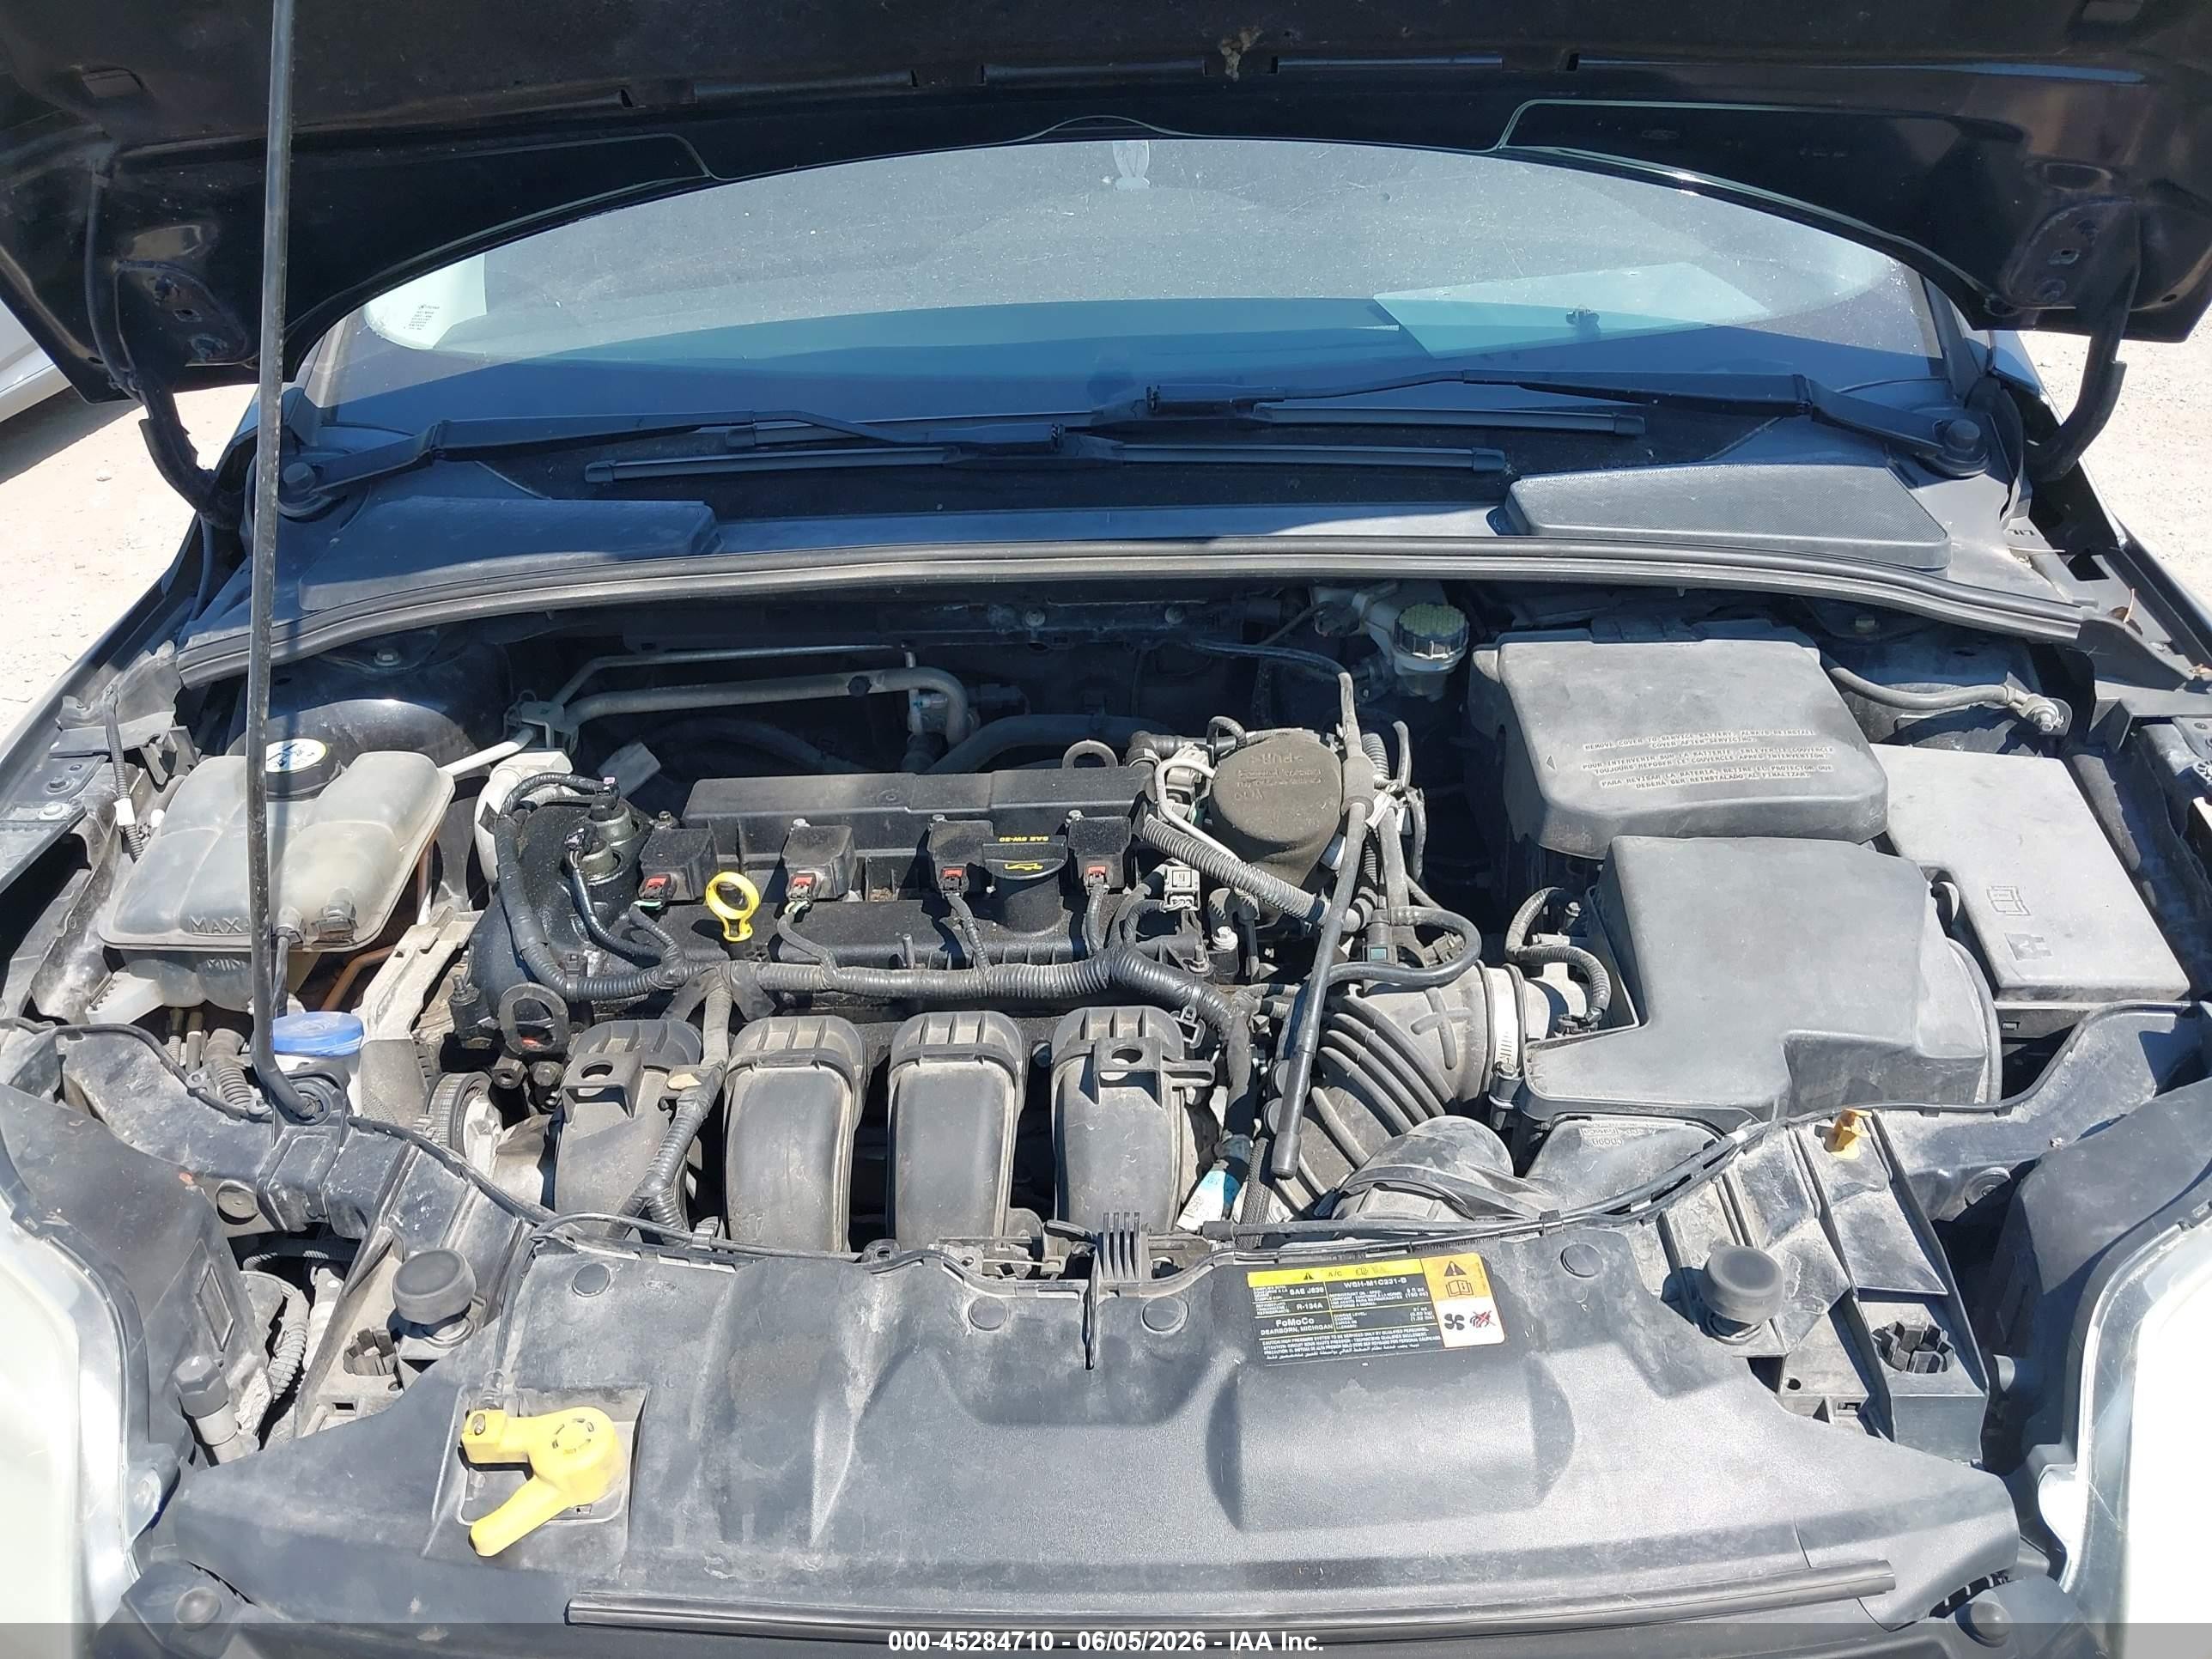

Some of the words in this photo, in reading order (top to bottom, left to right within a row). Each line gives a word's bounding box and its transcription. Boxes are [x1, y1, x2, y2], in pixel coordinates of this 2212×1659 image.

[190, 915, 242, 933] MAX
[207, 959, 241, 971] MIN
[1297, 1302, 1323, 1310] R-134A
[1276, 1317, 1315, 1327] FoMoCo
[1261, 1328, 1299, 1336] DEARBORN,
